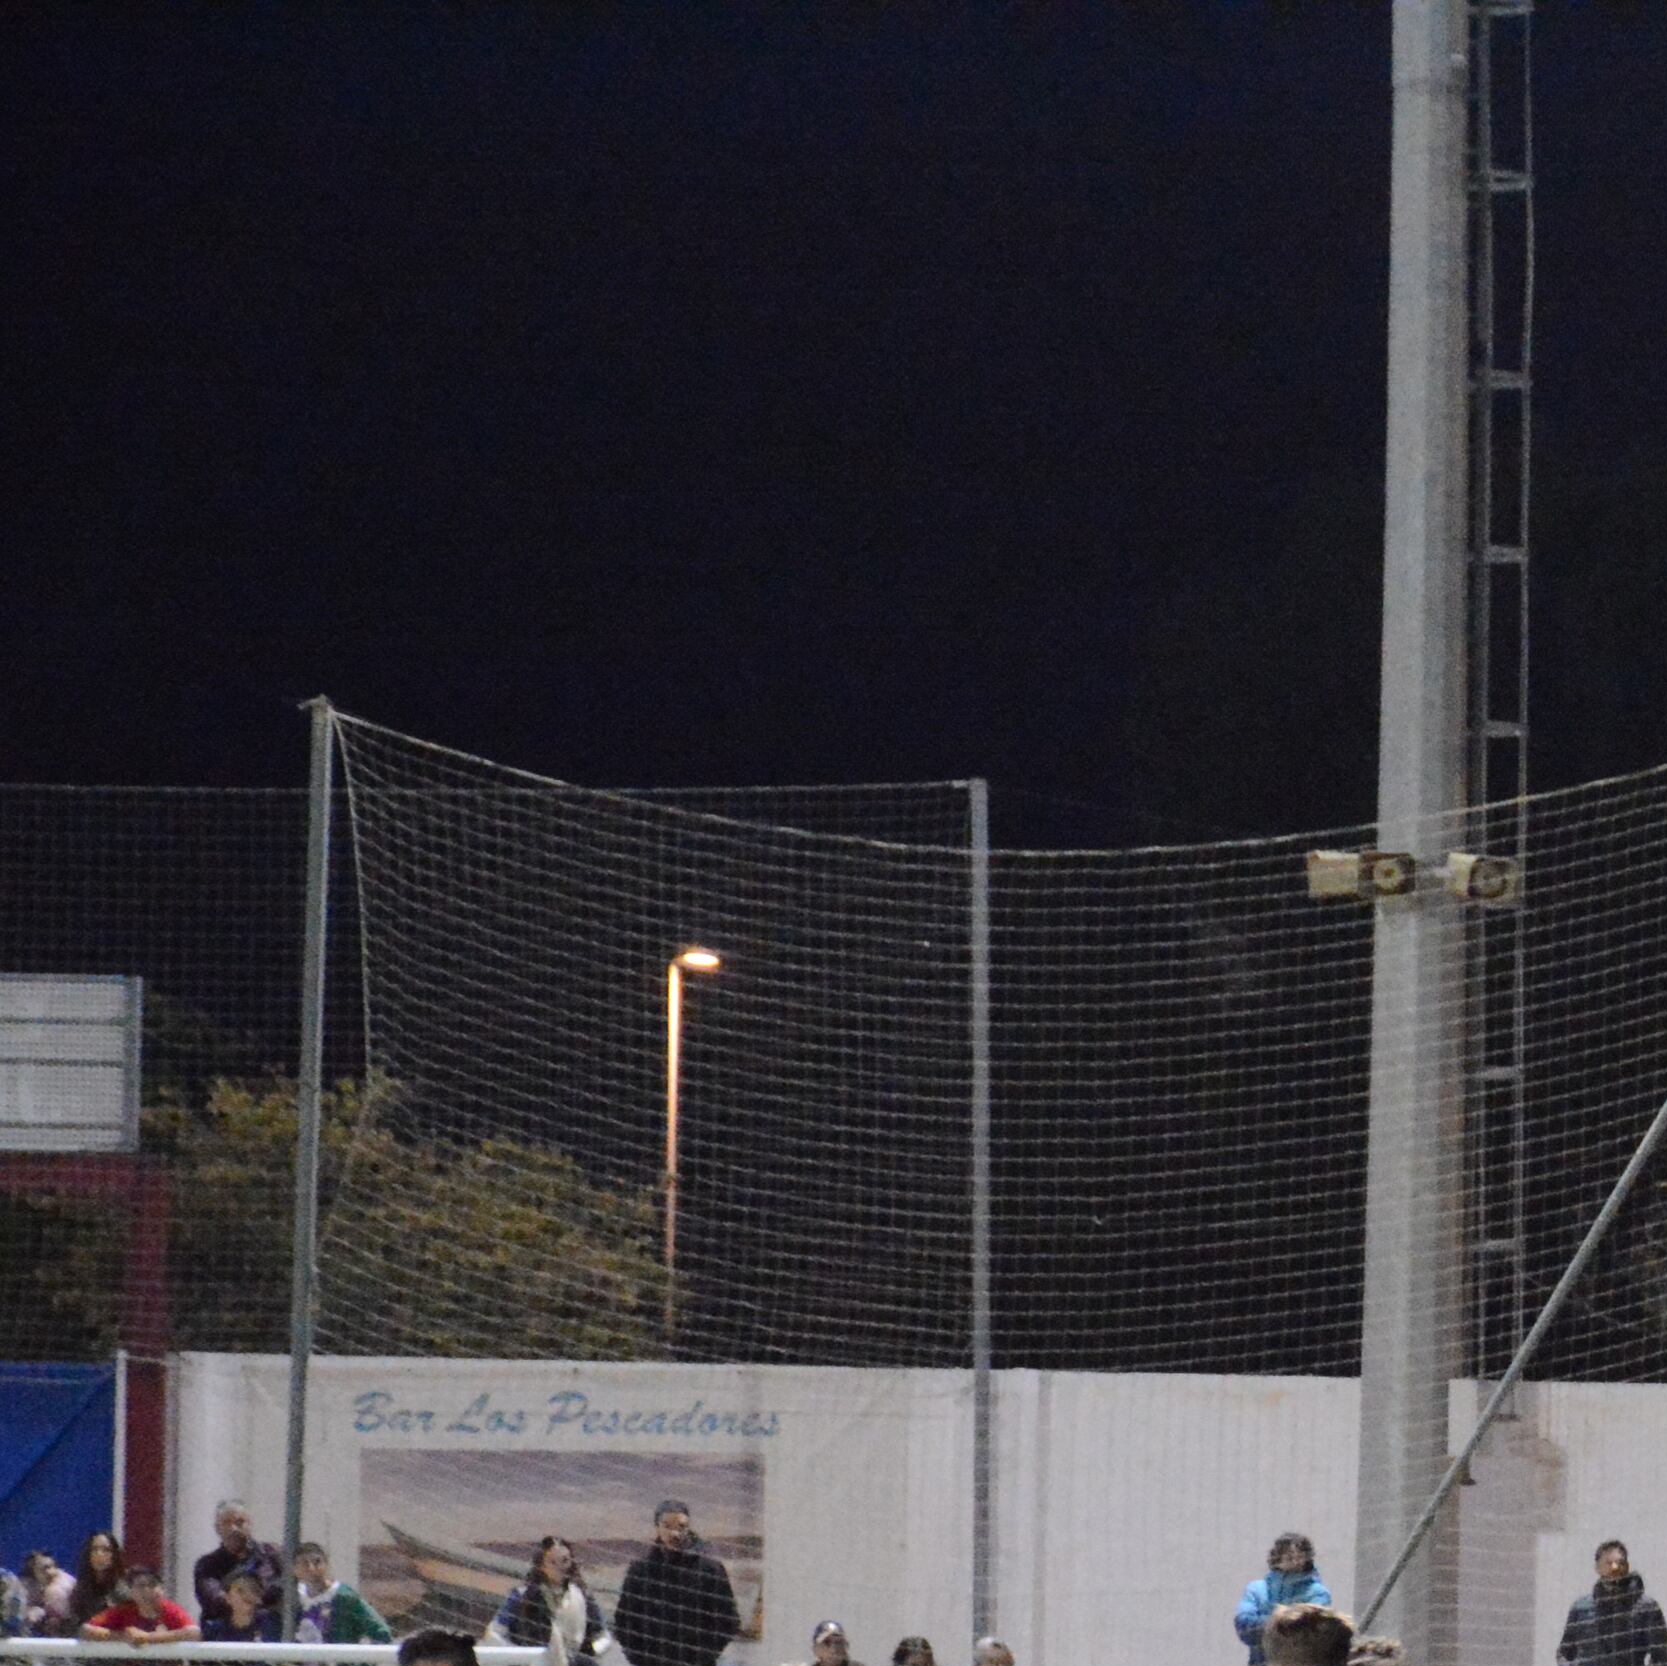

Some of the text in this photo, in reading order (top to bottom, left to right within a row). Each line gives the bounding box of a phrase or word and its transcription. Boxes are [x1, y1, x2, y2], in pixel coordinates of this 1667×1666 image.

[353, 1390, 781, 1438] Bar Los Pescadores
